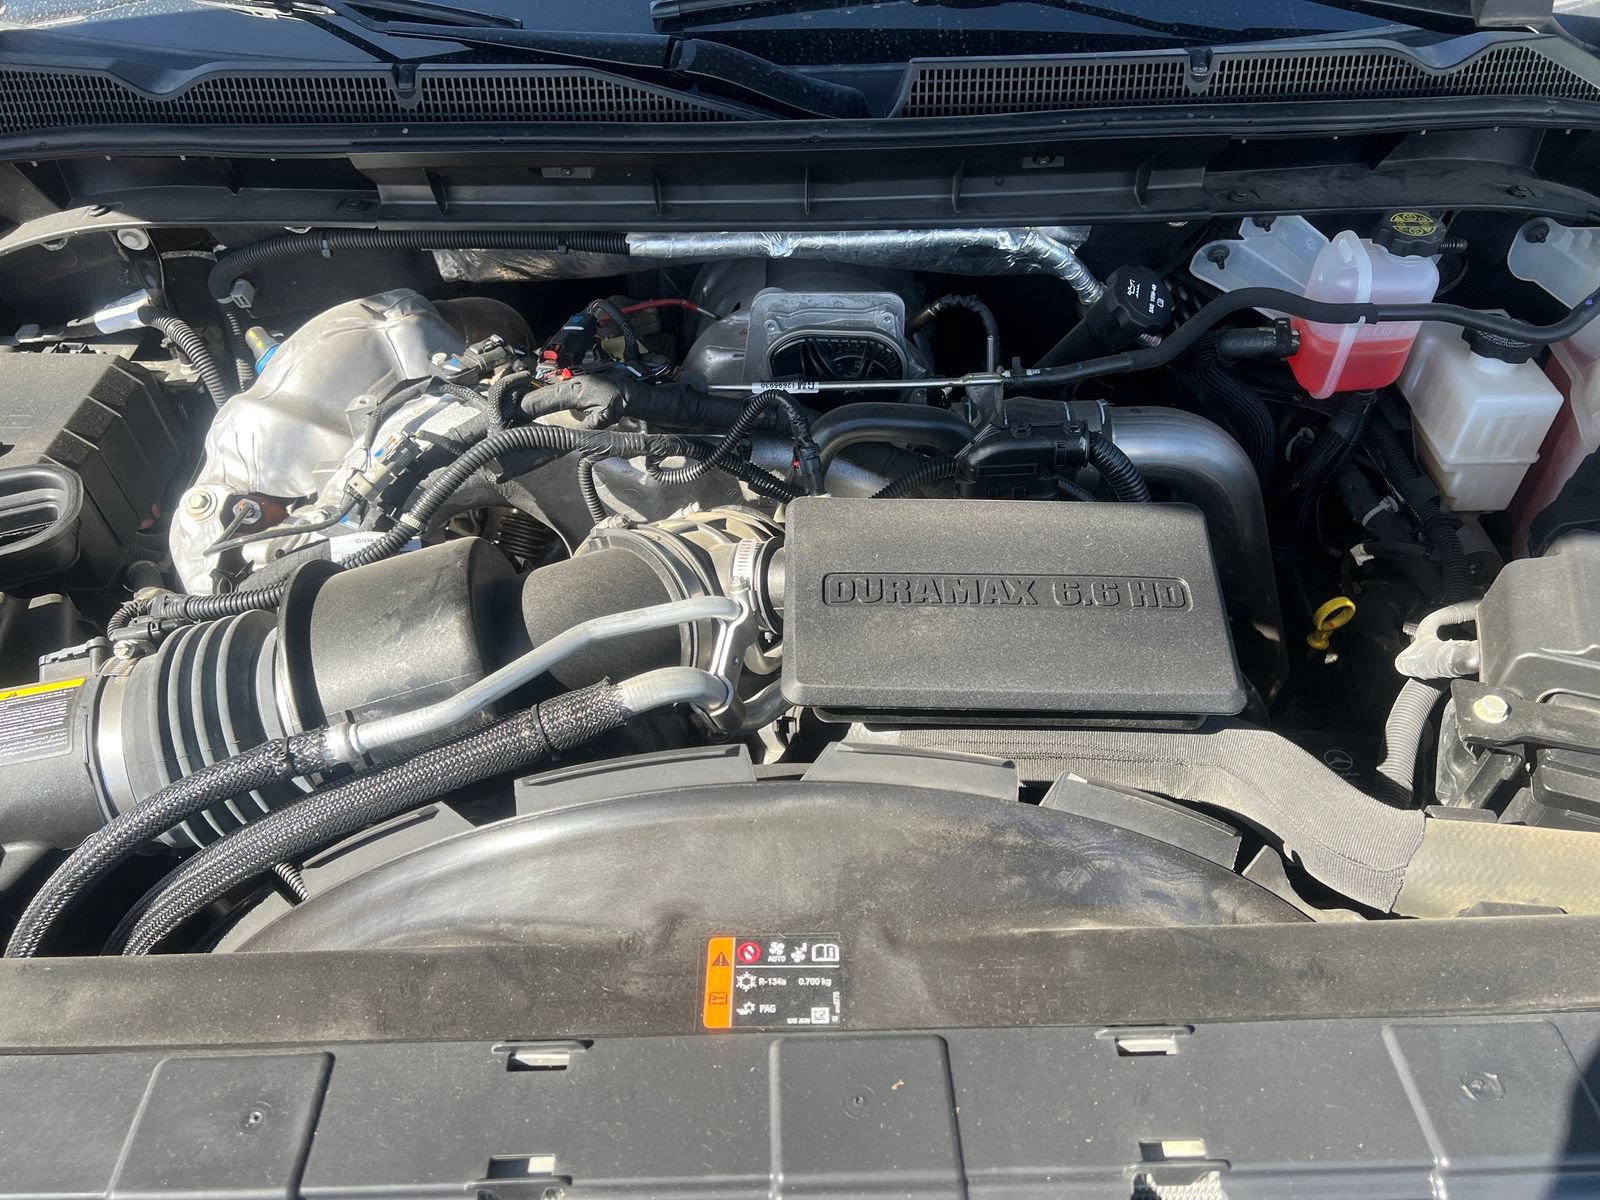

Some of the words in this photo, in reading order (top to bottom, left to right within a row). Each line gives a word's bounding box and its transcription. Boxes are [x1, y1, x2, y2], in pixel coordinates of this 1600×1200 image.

[828, 577, 1038, 606] DURAMAX
[1052, 581, 1121, 607] 6.6
[1127, 581, 1188, 609] HD
[767, 955, 787, 963] AUTO
[758, 978, 787, 986] R-134a
[798, 978, 820, 986] 0.700
[821, 977, 832, 987] kg
[759, 1004, 777, 1014] PAG
